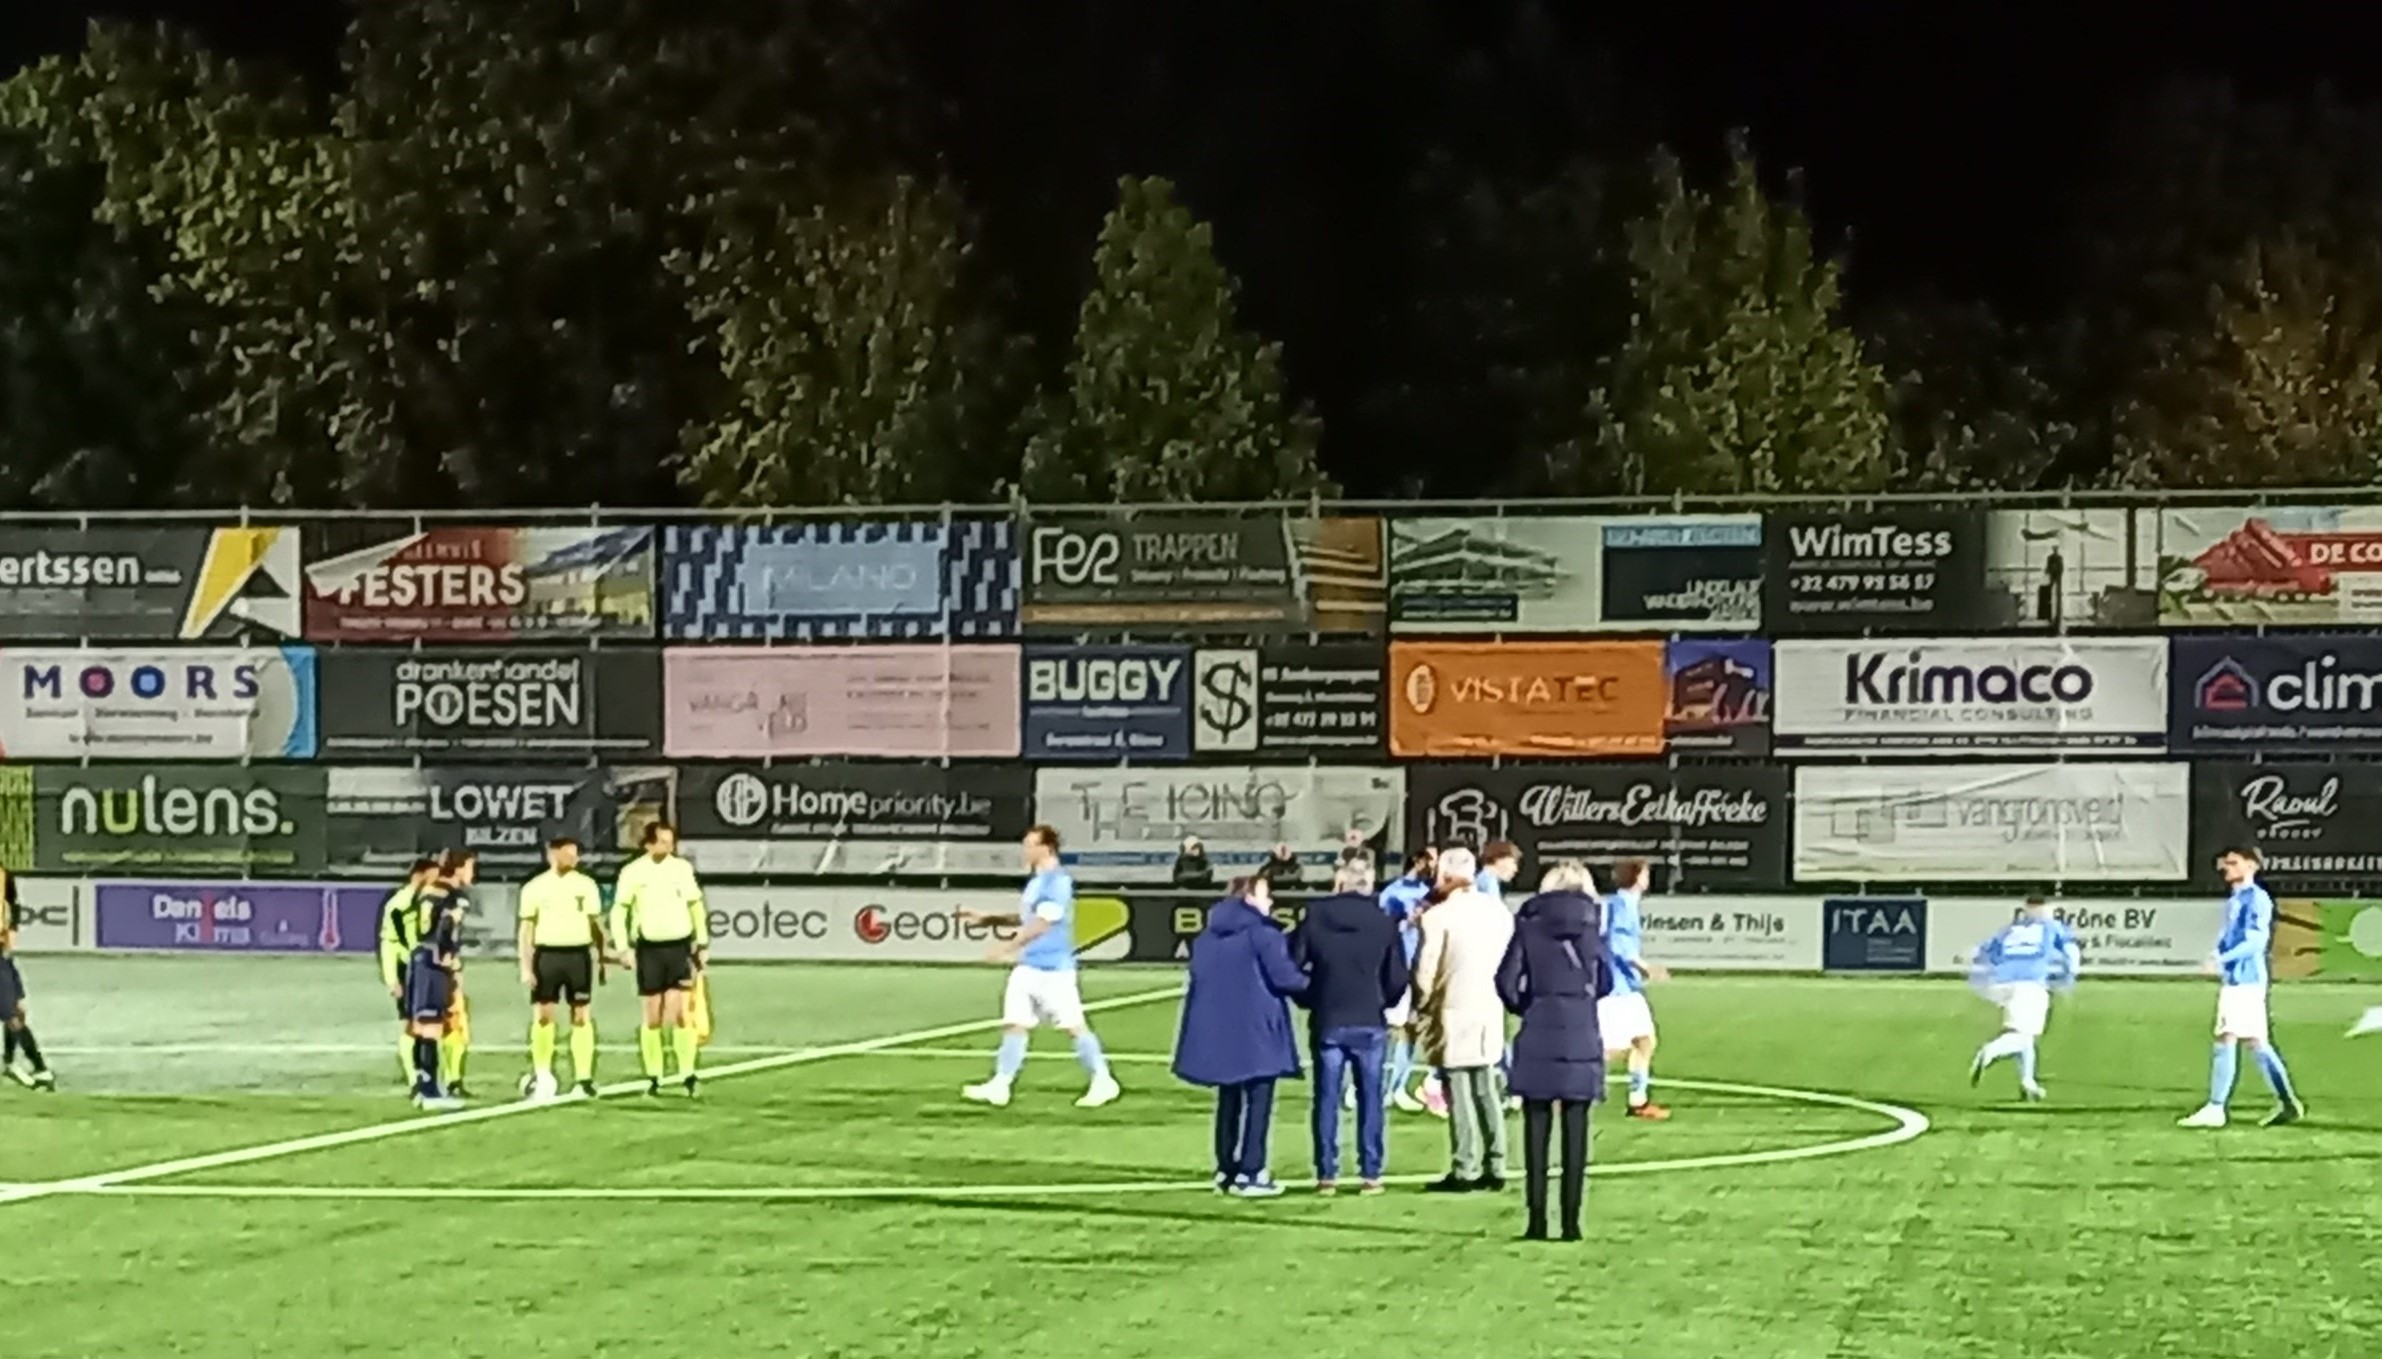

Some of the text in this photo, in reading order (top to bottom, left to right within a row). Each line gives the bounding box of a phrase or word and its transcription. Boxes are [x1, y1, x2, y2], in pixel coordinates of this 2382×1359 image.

[1789, 523, 1952, 557] WimTess
[2310, 543, 2382, 565] DE CO
[24, 665, 260, 699] MOORS
[1029, 659, 1182, 701] BUGGY
[1845, 650, 2094, 704] Krimaco
[2267, 655, 2382, 710] clim
[396, 683, 578, 726] POESEN
[62, 774, 294, 834] nulens.
[430, 784, 573, 819] LOWET
[2241, 775, 2339, 820] Raoul
[465, 826, 538, 846] BILZEN
[705, 903, 828, 939] eotec
[1832, 908, 1917, 934] ITAA
[2124, 908, 2156, 929] BV
